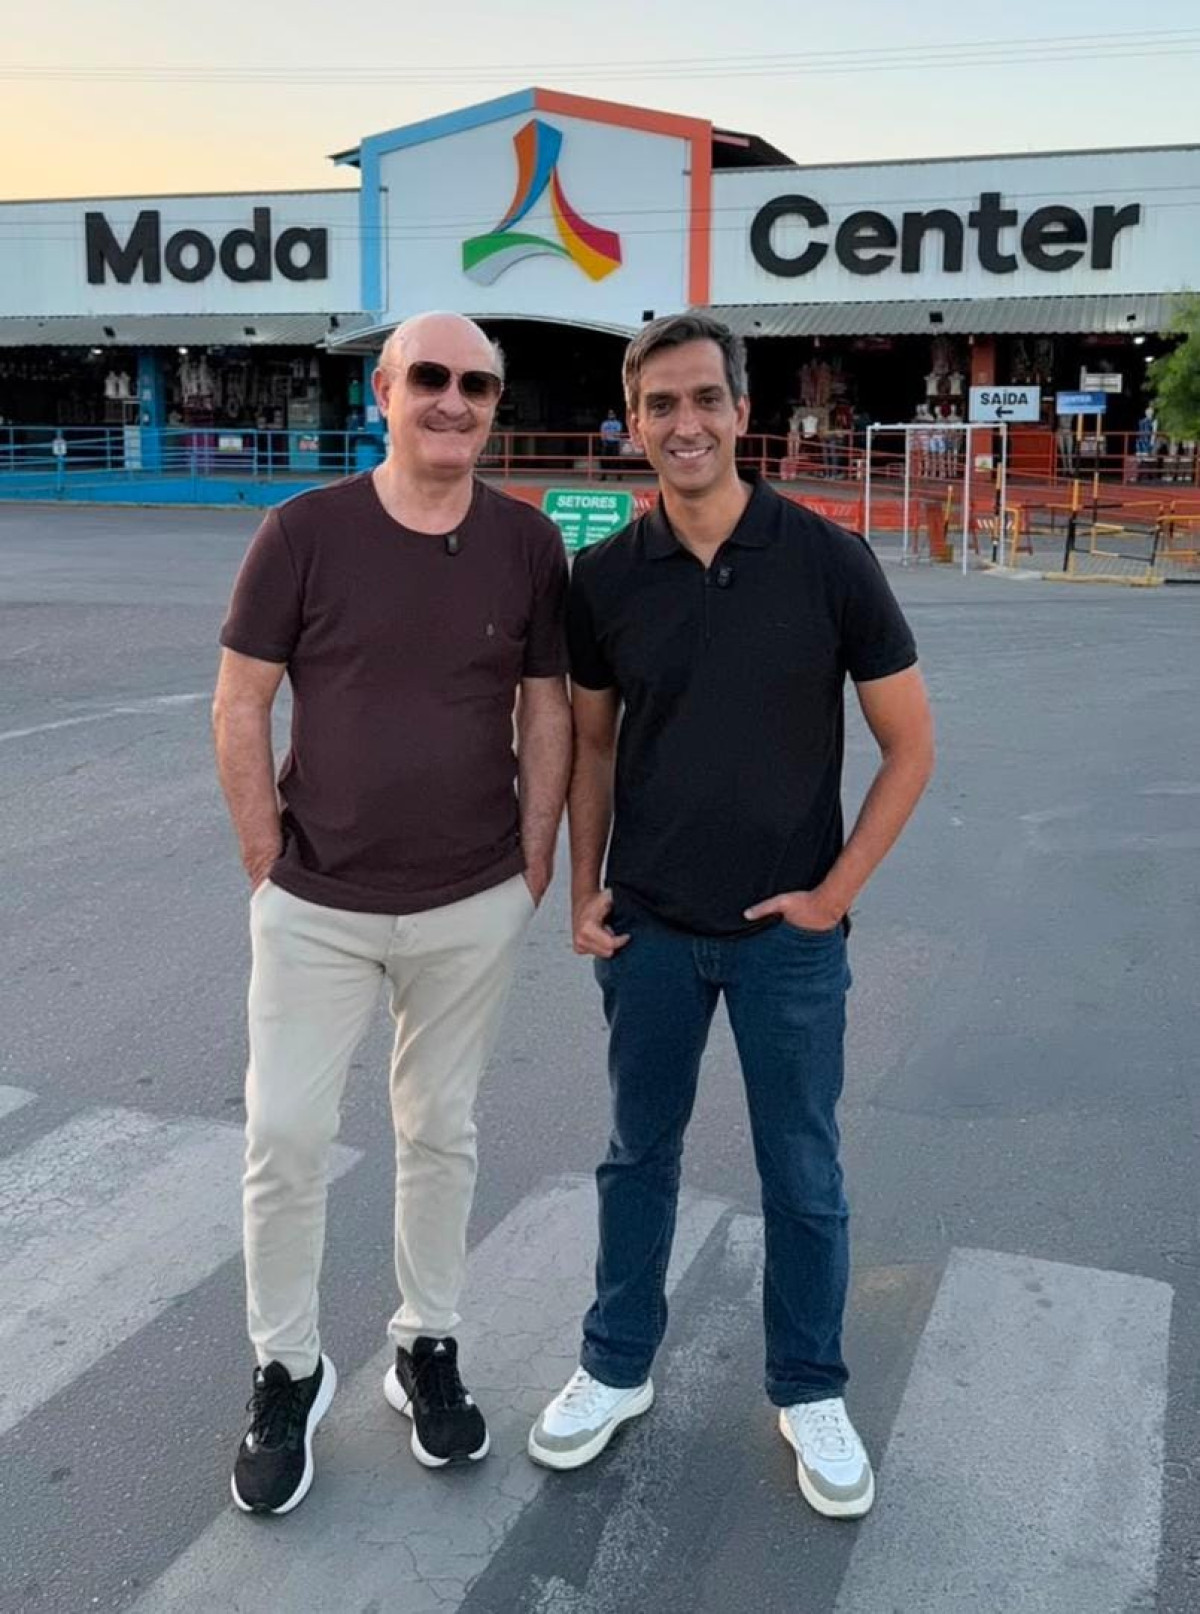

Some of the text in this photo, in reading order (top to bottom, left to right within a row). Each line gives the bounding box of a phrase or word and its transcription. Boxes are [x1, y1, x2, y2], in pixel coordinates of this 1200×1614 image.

[85, 192, 1140, 285] Moda Center
[980, 389, 1028, 405] SAÍDA
[556, 495, 618, 509] SETORES
